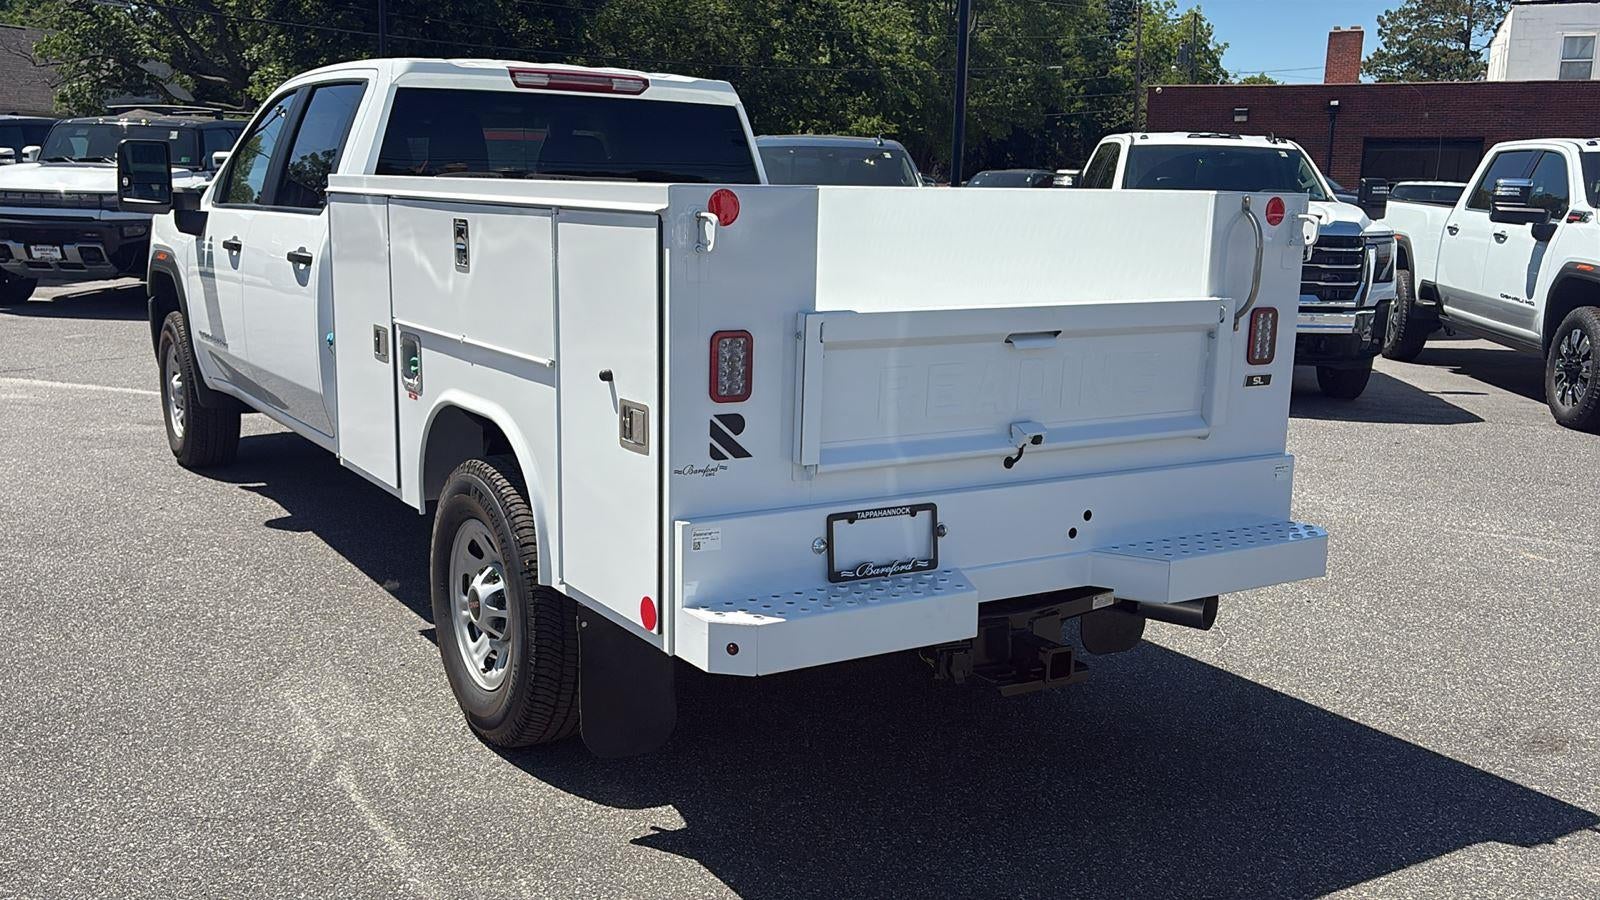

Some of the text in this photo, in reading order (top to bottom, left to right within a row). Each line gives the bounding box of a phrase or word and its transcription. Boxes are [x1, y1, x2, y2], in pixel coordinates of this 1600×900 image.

[1252, 376, 1264, 385] SL
[856, 506, 912, 520] TAPPAHANNOCK
[856, 557, 917, 578] Bareford
